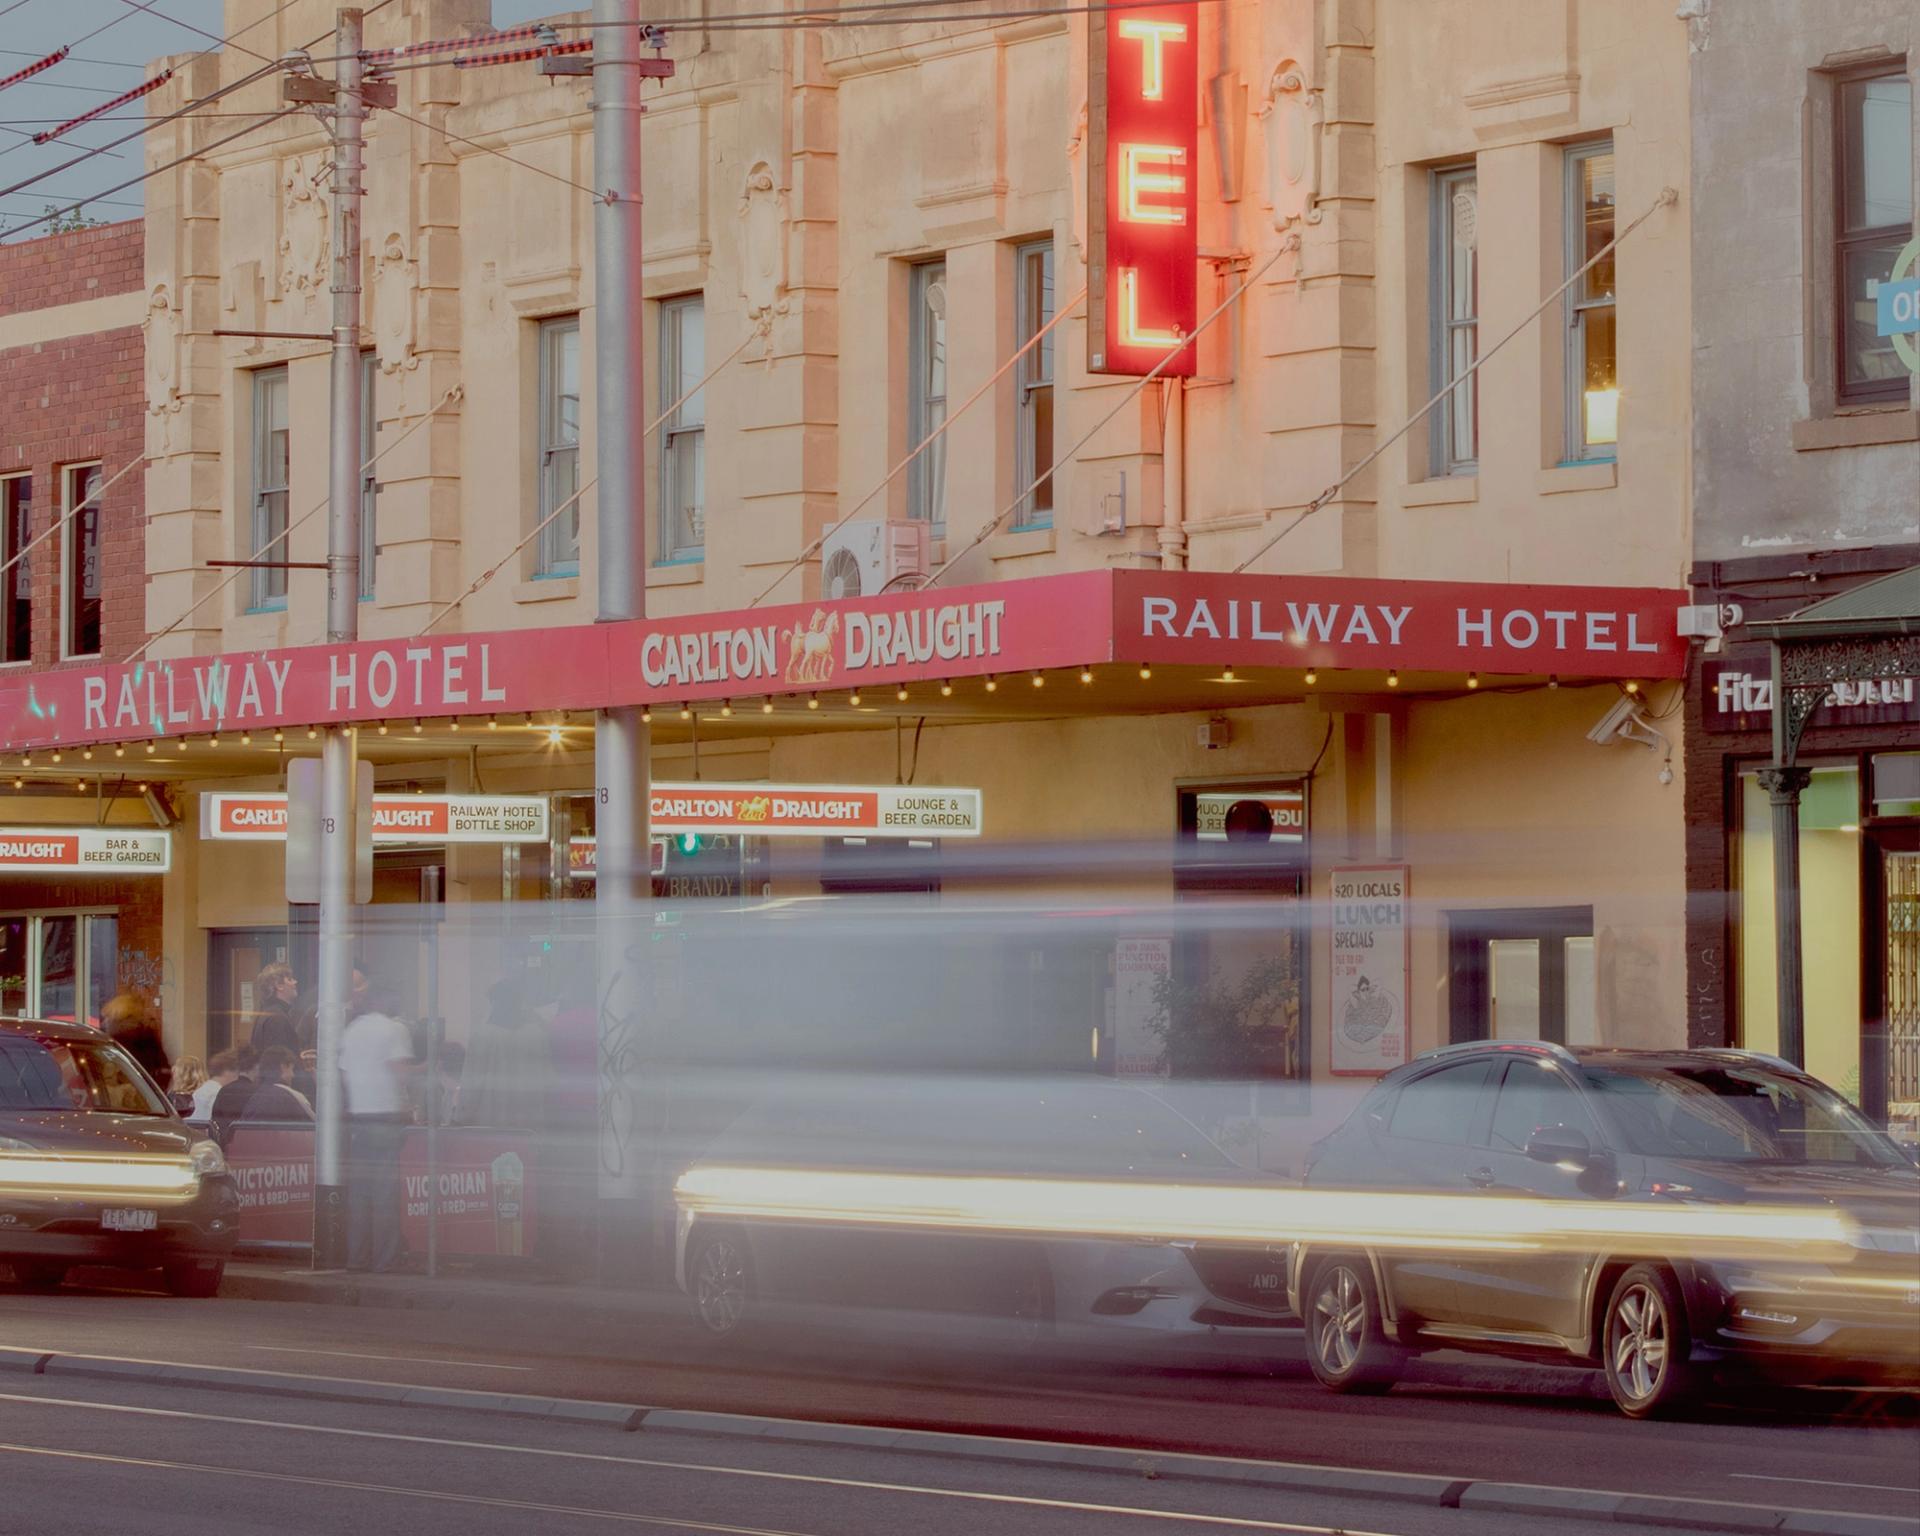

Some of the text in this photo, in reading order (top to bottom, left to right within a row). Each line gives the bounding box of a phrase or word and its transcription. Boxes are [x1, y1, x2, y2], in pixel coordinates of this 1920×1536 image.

[1141, 596, 1658, 653] RAILWAY HOTEL
[641, 599, 1006, 687] CARLTON DRAUGHT
[83, 642, 506, 730] RAILWAY HOTEL
[1717, 671, 1773, 713] Fitz
[450, 805, 542, 818] RAILWAY HOTEL
[651, 797, 864, 820] CARLTON DRAUGHT
[896, 798, 959, 810] LOUNGE &
[371, 809, 434, 827] AUGHT
[455, 819, 536, 832] BOTTLE SHOP
[884, 813, 971, 826] BEER GARDEN
[106, 839, 140, 849] BAR &
[84, 851, 161, 862] BEER GARDEN
[669, 875, 734, 898] BRANDY
[1335, 882, 1401, 898] $20 LOCALS
[1336, 903, 1401, 925] LUNCH
[1335, 931, 1375, 949] SPECIALS
[229, 1163, 308, 1190] VICTORIAN
[406, 1170, 486, 1199] VICORIAN
[234, 1191, 257, 1208] ORN
